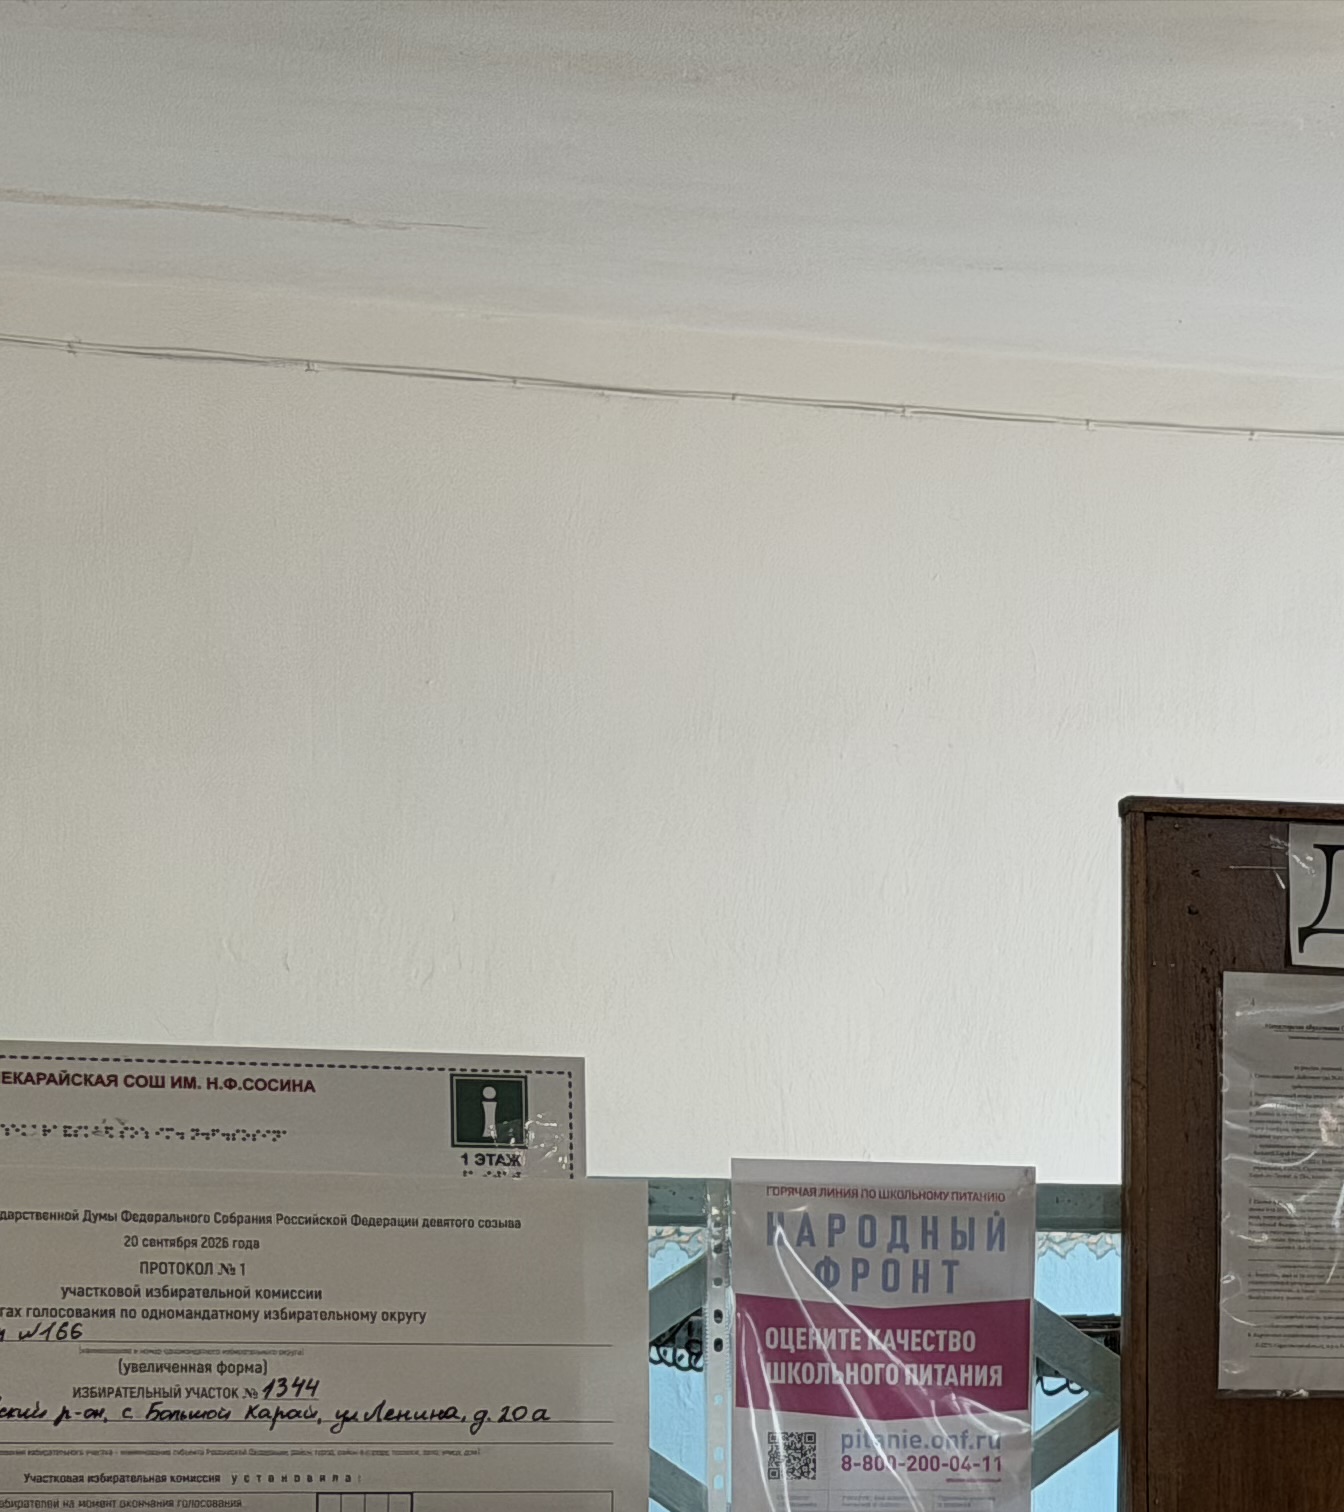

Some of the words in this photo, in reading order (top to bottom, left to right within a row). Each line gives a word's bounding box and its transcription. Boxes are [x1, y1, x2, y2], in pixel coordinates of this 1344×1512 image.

[1, 1070, 118, 1088] ЕКАРАЙСКАЯ
[124, 1074, 165, 1089] СОШ
[171, 1076, 201, 1090] ИМ.
[207, 1077, 316, 1093] Н.Ф.СОСИНА
[461, 1152, 469, 1166] 1
[474, 1153, 522, 1167] ЭТАЖ
[766, 1185, 817, 1198] ГОРЯЧАЯ
[818, 1187, 859, 1199] ЛИНИЯ
[861, 1188, 876, 1199] ПО
[878, 1189, 950, 1202] ШКОЛЬНОМУ
[951, 1190, 1006, 1203] ПИТАНИЮ
[82, 1209, 117, 1224] Думы
[121, 1210, 210, 1225] Федерального
[214, 1212, 273, 1226] Собрания
[276, 1213, 347, 1227] Российской
[351, 1214, 418, 1229] Федерации
[422, 1216, 475, 1229] девятого
[478, 1218, 522, 1229] созыва
[766, 1209, 1006, 1254] НАРОДНЫЙ
[123, 1235, 138, 1248] 20
[142, 1236, 198, 1250] сентября
[200, 1236, 229, 1249] 2026
[232, 1238, 260, 1250] года
[140, 1261, 213, 1276] ПРОТОКОЛ
[217, 1263, 236, 1276] №
[240, 1263, 246, 1276] 1
[814, 1255, 960, 1295] ФРОНТ
[60, 1284, 141, 1299] участковой
[146, 1285, 250, 1300] избирательной
[255, 1287, 323, 1300] комиссии
[26, 1307, 116, 1319] голосования
[120, 1308, 137, 1319] по
[141, 1308, 259, 1322] одномандатному
[264, 1307, 377, 1324] избирательному
[381, 1310, 427, 1324] округу
[765, 1326, 862, 1356] ОЦЕНИТЕ
[867, 1328, 977, 1354] КАЧЕСТВО
[118, 1358, 212, 1376] (увеличенная
[216, 1359, 268, 1376] форма)
[765, 1361, 899, 1387] ШКОЛЬНОГО
[904, 1363, 1003, 1388] ПИТАНИЯ
[72, 1384, 182, 1399] ИЗБИРАТЕЛЬНЫЙ
[185, 1386, 238, 1399] УЧАСТОК
[261, 1376, 320, 1399] 1344
[146, 1401, 231, 1421] Большой
[244, 1404, 322, 1430] Карай,
[841, 1429, 1001, 1453] pitanie.onf.ru
[841, 1454, 1002, 1473] 8-800-200-04-11
[24, 1472, 84, 1484] Участковая
[88, 1473, 167, 1485] избирательная
[170, 1473, 221, 1484] комиссия
